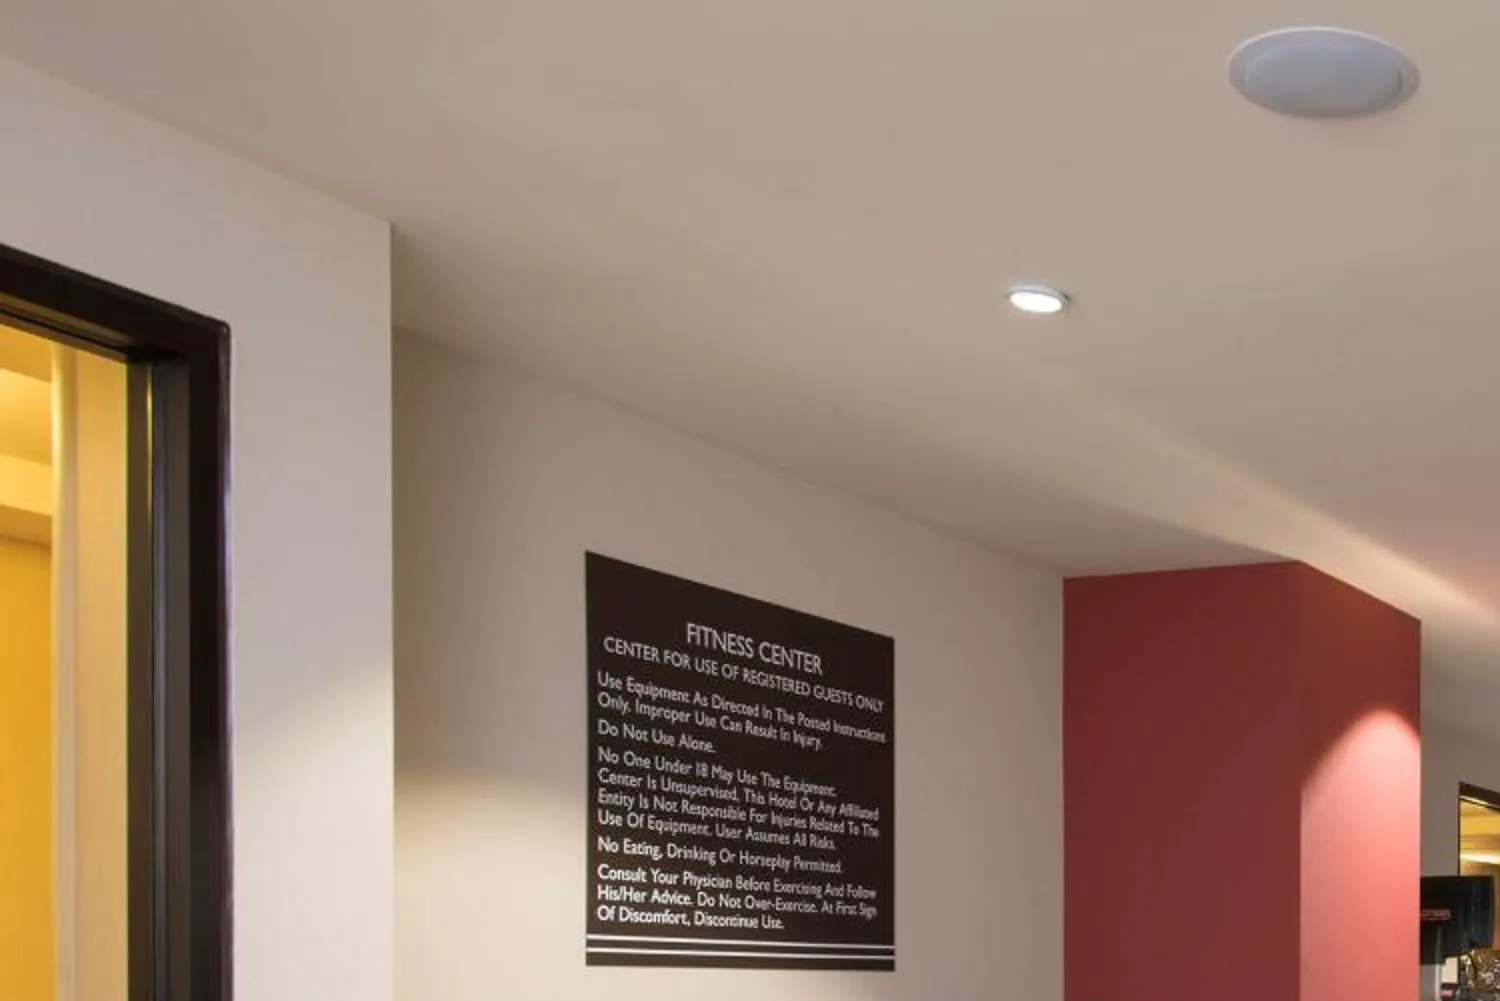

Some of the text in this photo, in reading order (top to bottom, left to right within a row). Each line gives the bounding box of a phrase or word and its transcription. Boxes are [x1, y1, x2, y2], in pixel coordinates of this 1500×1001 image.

[686, 622, 823, 675] FITNESS CENTER
[603, 636, 885, 713] CENTER FOR USE OF REGISTERED GUESTS ONLY
[597, 671, 623, 690] Use
[626, 675, 690, 703] Equipment
[692, 691, 708, 707] As
[711, 694, 760, 717] Directed
[762, 705, 773, 720] In
[775, 707, 795, 725] The
[797, 711, 831, 732] Posted
[597, 691, 823, 751] Only. Improper Use Can Result In Injury.
[597, 719, 716, 753] Do Not Use Alone.
[597, 746, 619, 764] No
[623, 750, 651, 768] One
[654, 755, 693, 775] Under
[695, 762, 708, 777] 18
[711, 764, 734, 784] May
[737, 768, 759, 785] Use
[760, 771, 781, 788] The
[597, 767, 879, 821] Center Is Unsupervised. This Hotel Or Any Affiliated
[597, 787, 880, 838] Entity Is Not Responsible For Injuries Related To The
[597, 808, 623, 826] Use
[627, 811, 645, 829] Of
[715, 823, 743, 840] User
[745, 825, 790, 845] Assumes
[793, 831, 807, 847] All
[597, 835, 619, 852] No
[623, 837, 663, 861] Eating,
[667, 842, 717, 866] Drinking
[719, 848, 737, 863] Or
[739, 850, 790, 874] Horseplay
[597, 863, 877, 899] Consult Your Physician Before Exercising And Follow
[597, 884, 648, 903] His/Her
[650, 888, 695, 906] Advice.
[697, 892, 715, 907] Do
[719, 893, 742, 909] Not
[821, 900, 834, 915] At
[835, 901, 858, 916] First
[859, 902, 878, 920] Sign
[597, 905, 785, 930] Of Discomfort, Discontinue Use.
